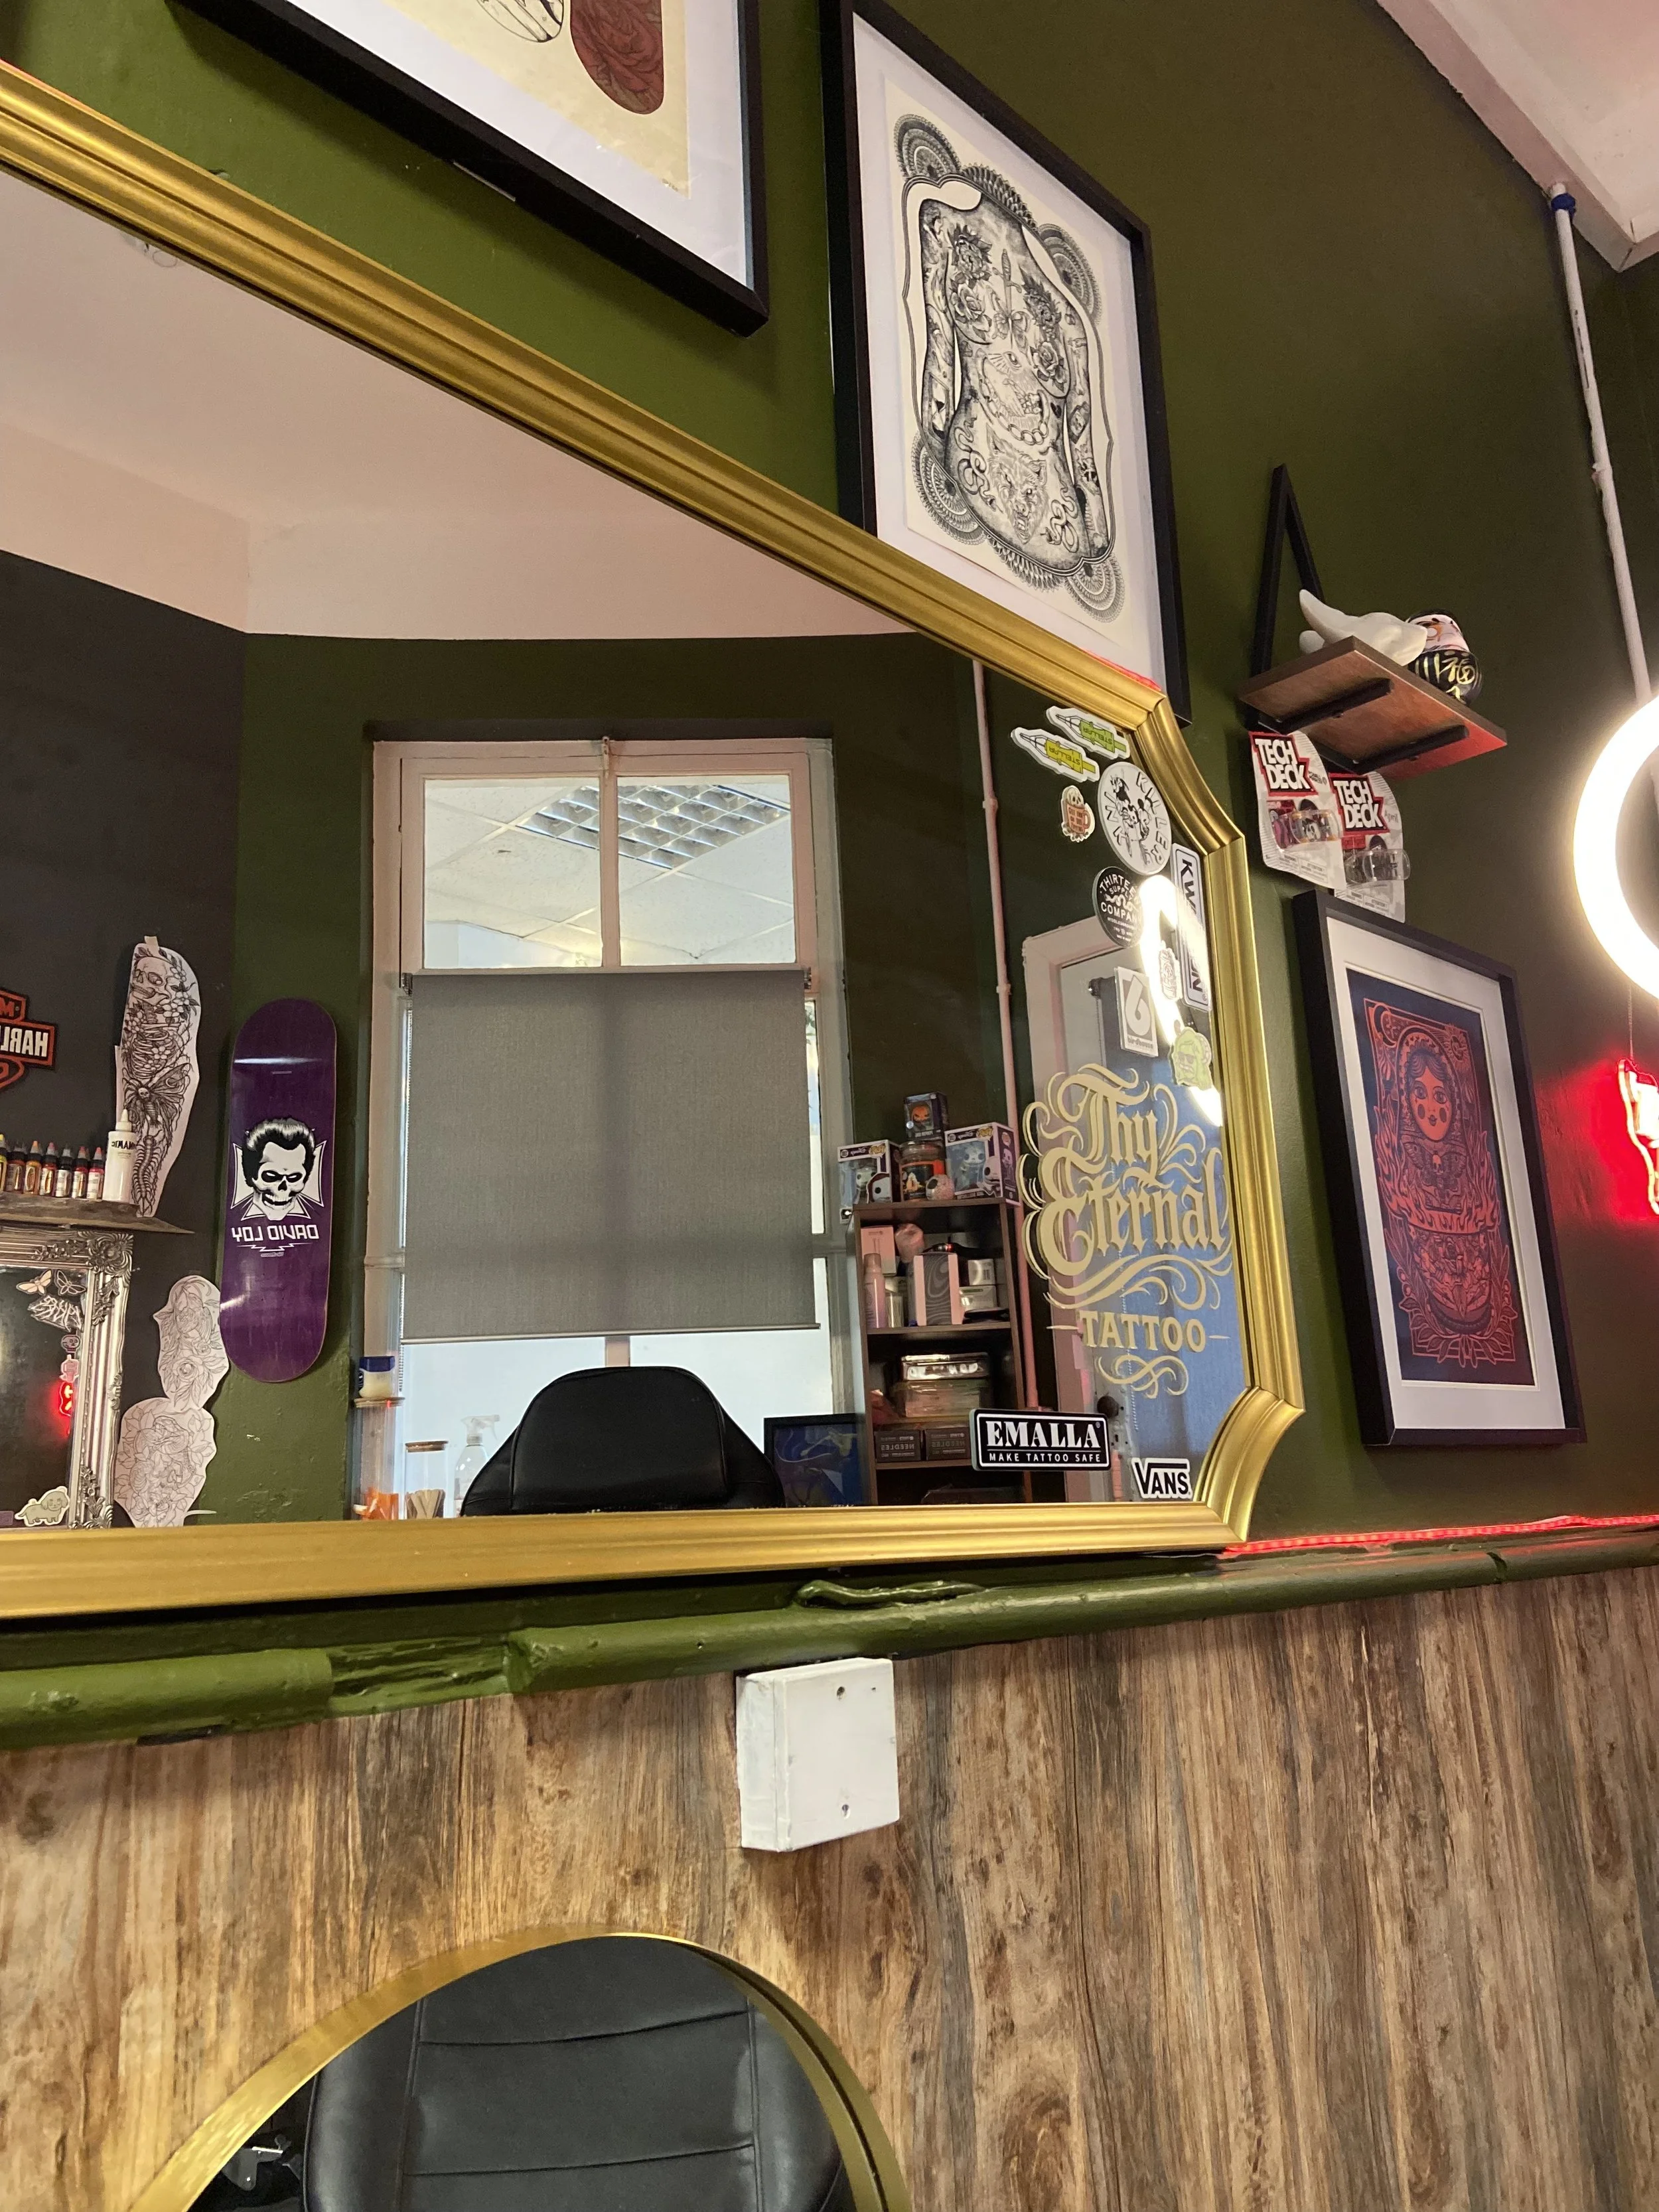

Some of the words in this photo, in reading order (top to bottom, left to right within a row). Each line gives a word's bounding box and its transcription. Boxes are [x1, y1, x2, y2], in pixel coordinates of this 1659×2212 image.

[1083, 727, 1113, 745] STELLAR
[1048, 746, 1082, 765] STELLAR
[1255, 738, 1299, 765] TECH
[1265, 764, 1311, 790] DECK
[1333, 780, 1374, 804] TECH
[1104, 790, 1129, 846] INK
[1136, 771, 1169, 864] KILLER
[1342, 803, 1384, 829] DECK
[1109, 885, 1133, 901] SUPPLY
[1101, 902, 1139, 924] COMPAN
[1055, 1063, 1165, 1185] Thy
[1039, 1147, 1226, 1276] Eternal
[1078, 1310, 1206, 1353] TATTOO
[985, 1420, 1101, 1449] EMALLA
[989, 1452, 1020, 1462] MAKE
[1026, 1453, 1069, 1463] TATTOO
[1075, 1453, 1101, 1463] SAFE
[1135, 1462, 1189, 1495] VANS
